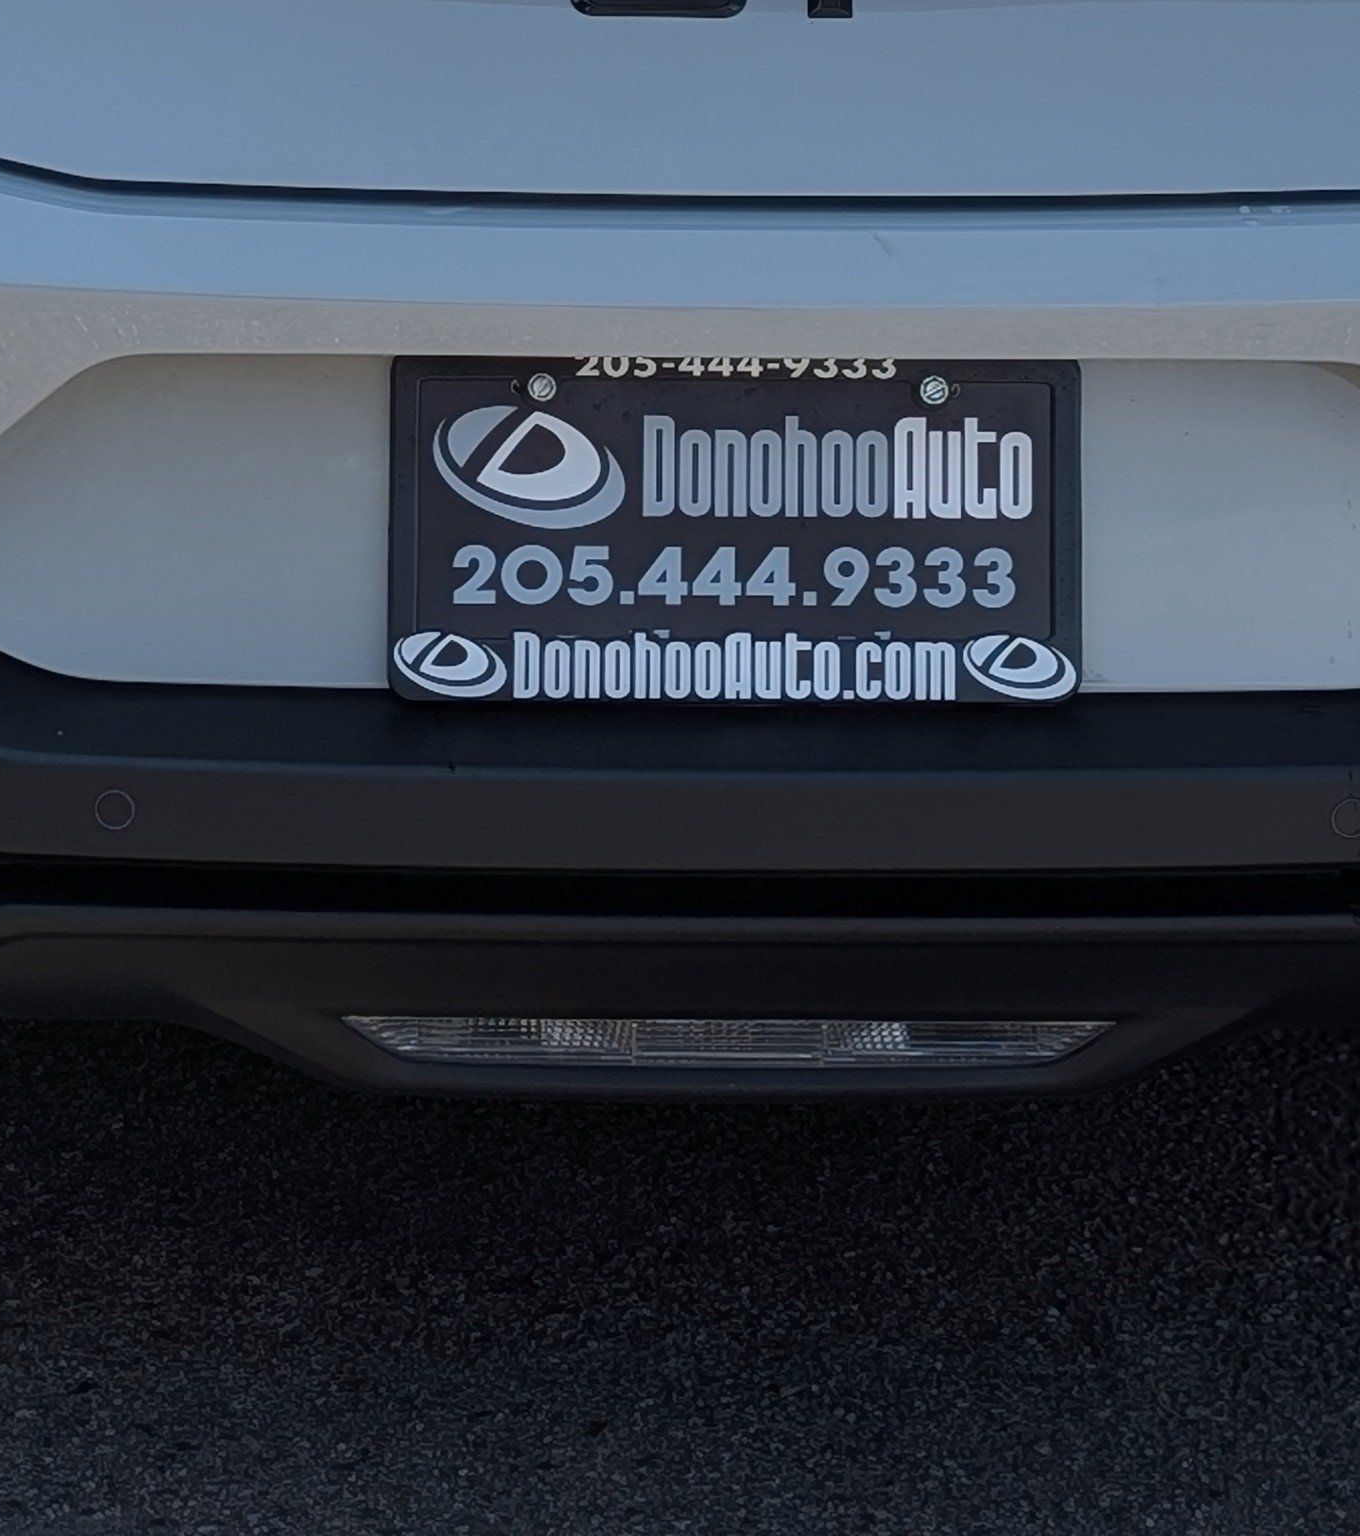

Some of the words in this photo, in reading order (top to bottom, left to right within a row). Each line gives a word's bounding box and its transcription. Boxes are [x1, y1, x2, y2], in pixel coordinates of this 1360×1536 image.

[643, 415, 1033, 519] DonohooAuto
[452, 544, 1016, 608] 205.444.9333
[512, 631, 957, 700] DonohooAuto.com
